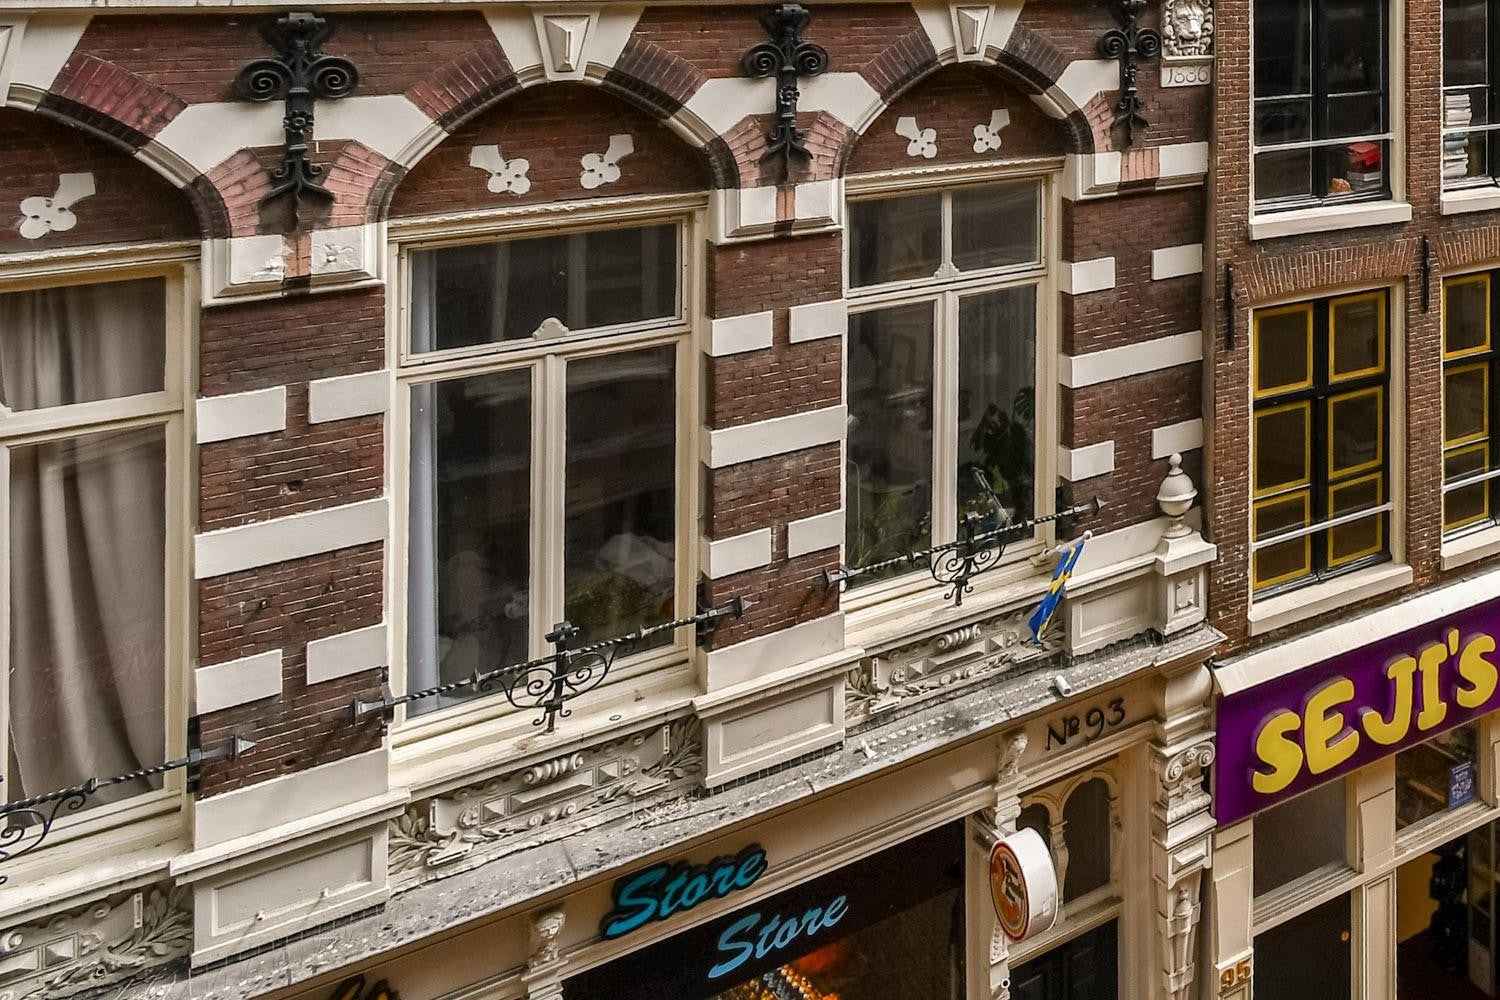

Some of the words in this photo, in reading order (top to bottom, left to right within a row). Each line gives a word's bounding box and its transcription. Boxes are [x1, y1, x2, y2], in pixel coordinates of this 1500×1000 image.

[1247, 625, 1499, 795] SEJI'S
[605, 849, 766, 937] Store
[707, 894, 849, 979] Store
[1220, 959, 1251, 987] 95
